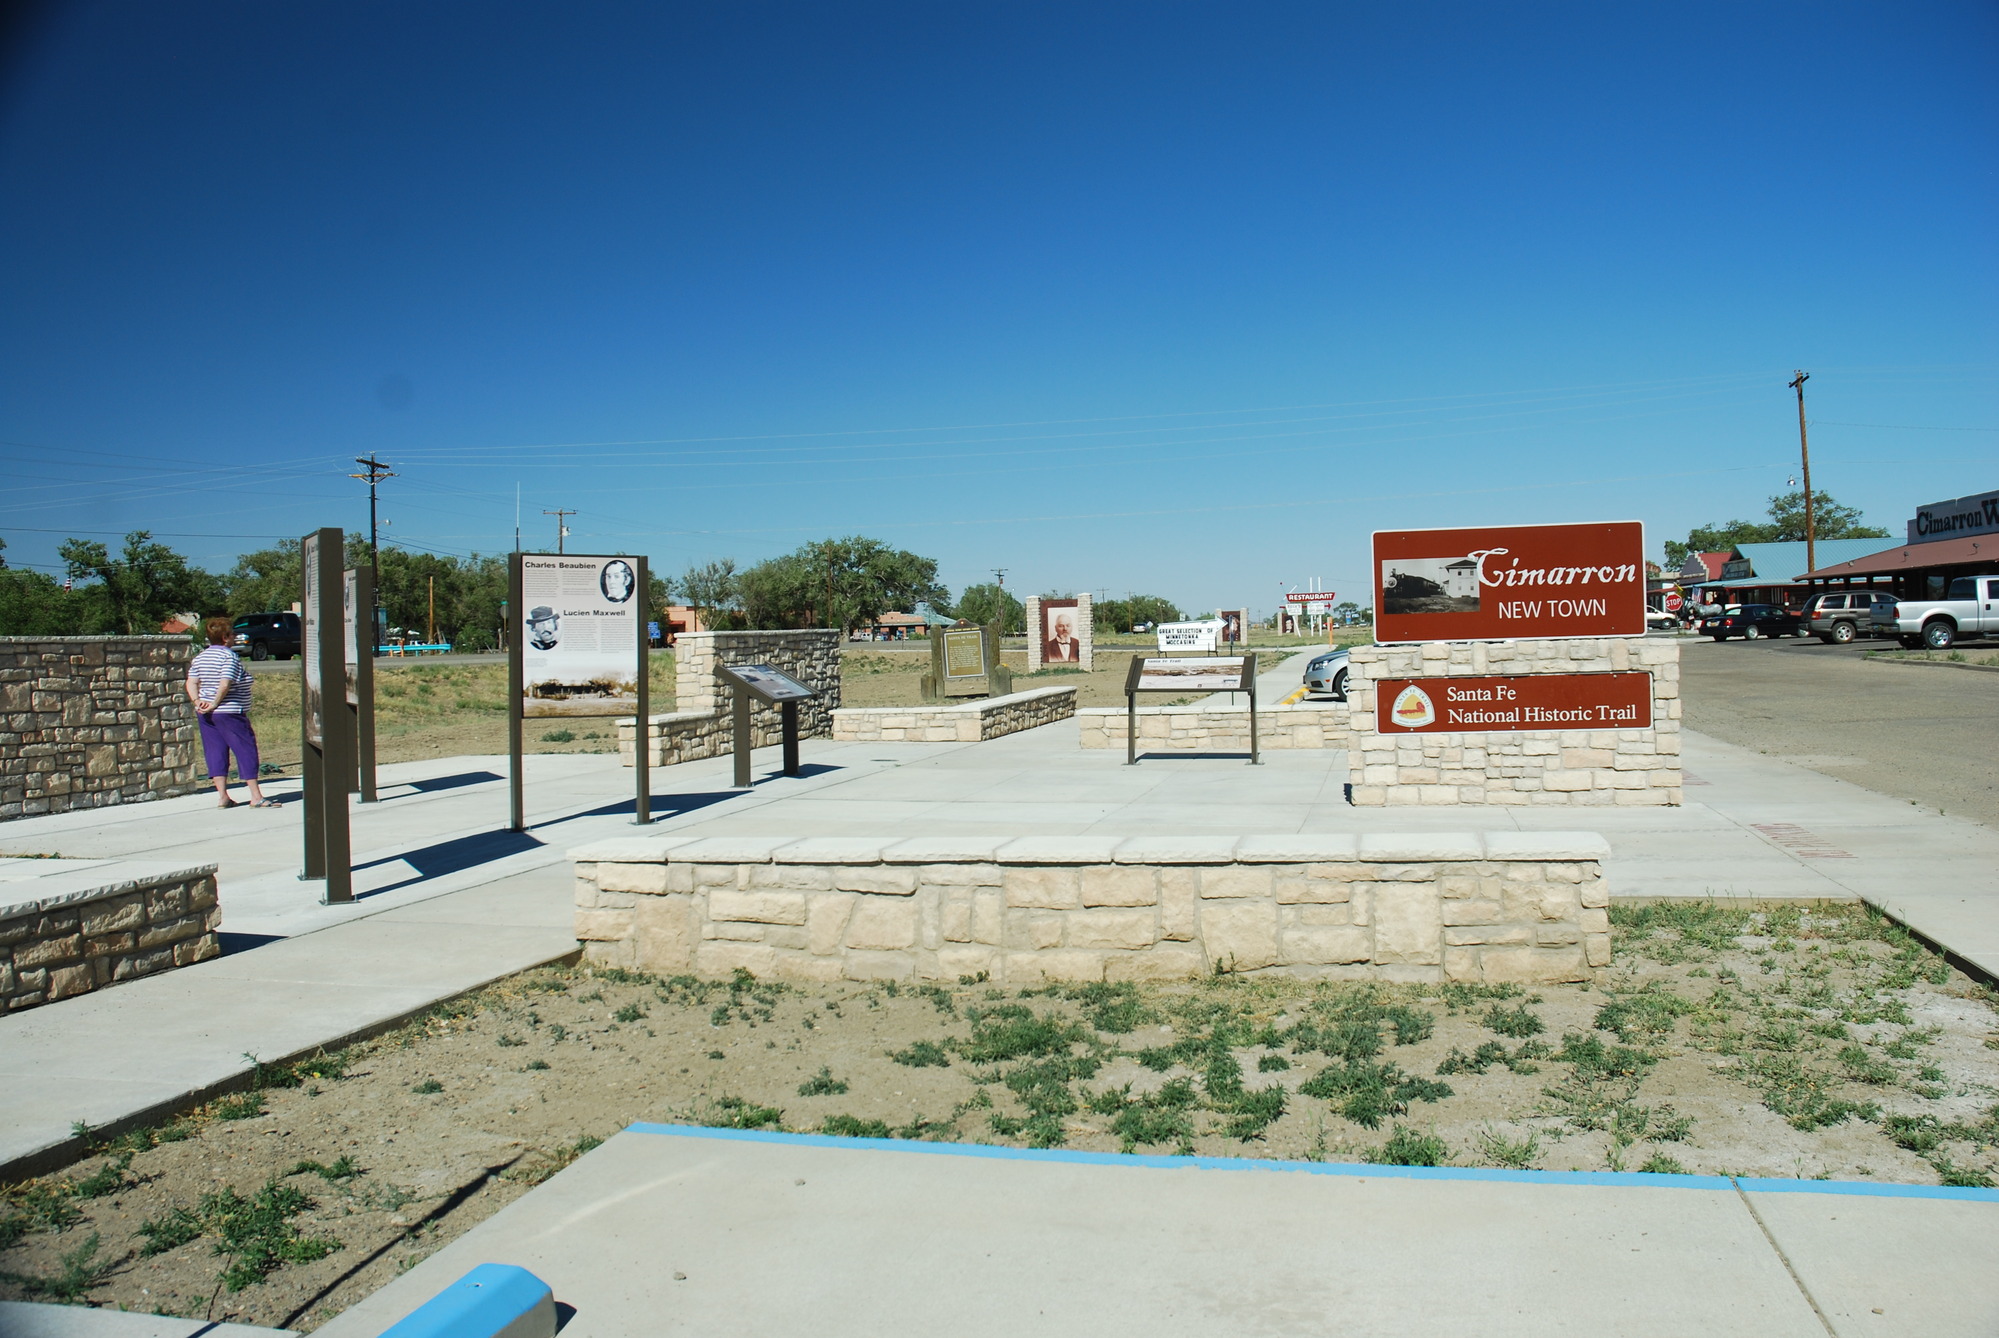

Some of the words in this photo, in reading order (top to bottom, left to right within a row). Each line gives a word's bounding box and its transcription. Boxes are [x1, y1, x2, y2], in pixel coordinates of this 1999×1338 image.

[1916, 511, 1983, 536] Cimarron
[524, 561, 556, 569] Charles
[1467, 547, 1636, 587] Cimarron
[1288, 593, 1333, 601] RESTAURANT
[1665, 598, 1681, 607] STOP
[1498, 601, 1542, 619] NEW
[1547, 599, 1606, 618] TOWN
[1446, 686, 1493, 702] Santa
[1495, 685, 1517, 701] Fe
[1447, 707, 1521, 724] National
[1523, 705, 1593, 723] Historic
[1595, 704, 1637, 720] Trail
